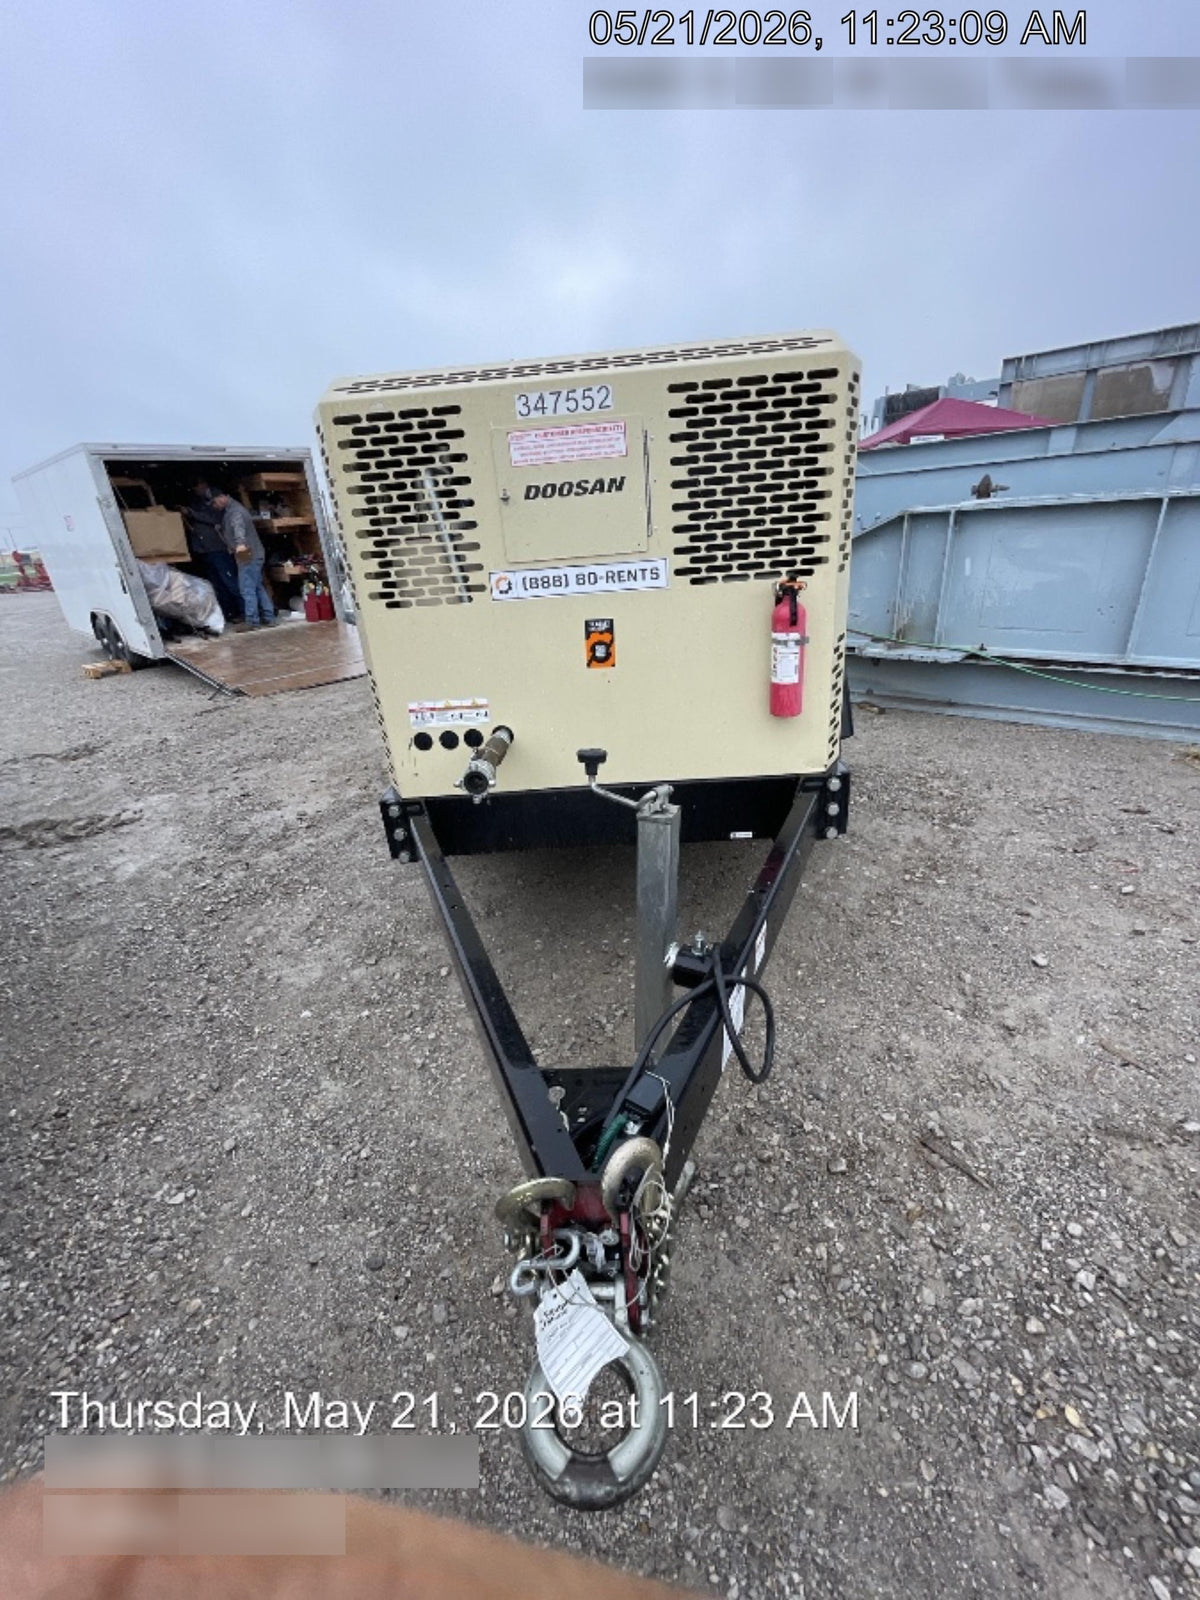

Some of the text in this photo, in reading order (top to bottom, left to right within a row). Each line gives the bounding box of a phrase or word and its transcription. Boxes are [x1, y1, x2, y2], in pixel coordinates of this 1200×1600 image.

[516, 385, 611, 417] 347552
[524, 476, 626, 500] DOOSAN
[575, 566, 660, 586] 80-RENTS
